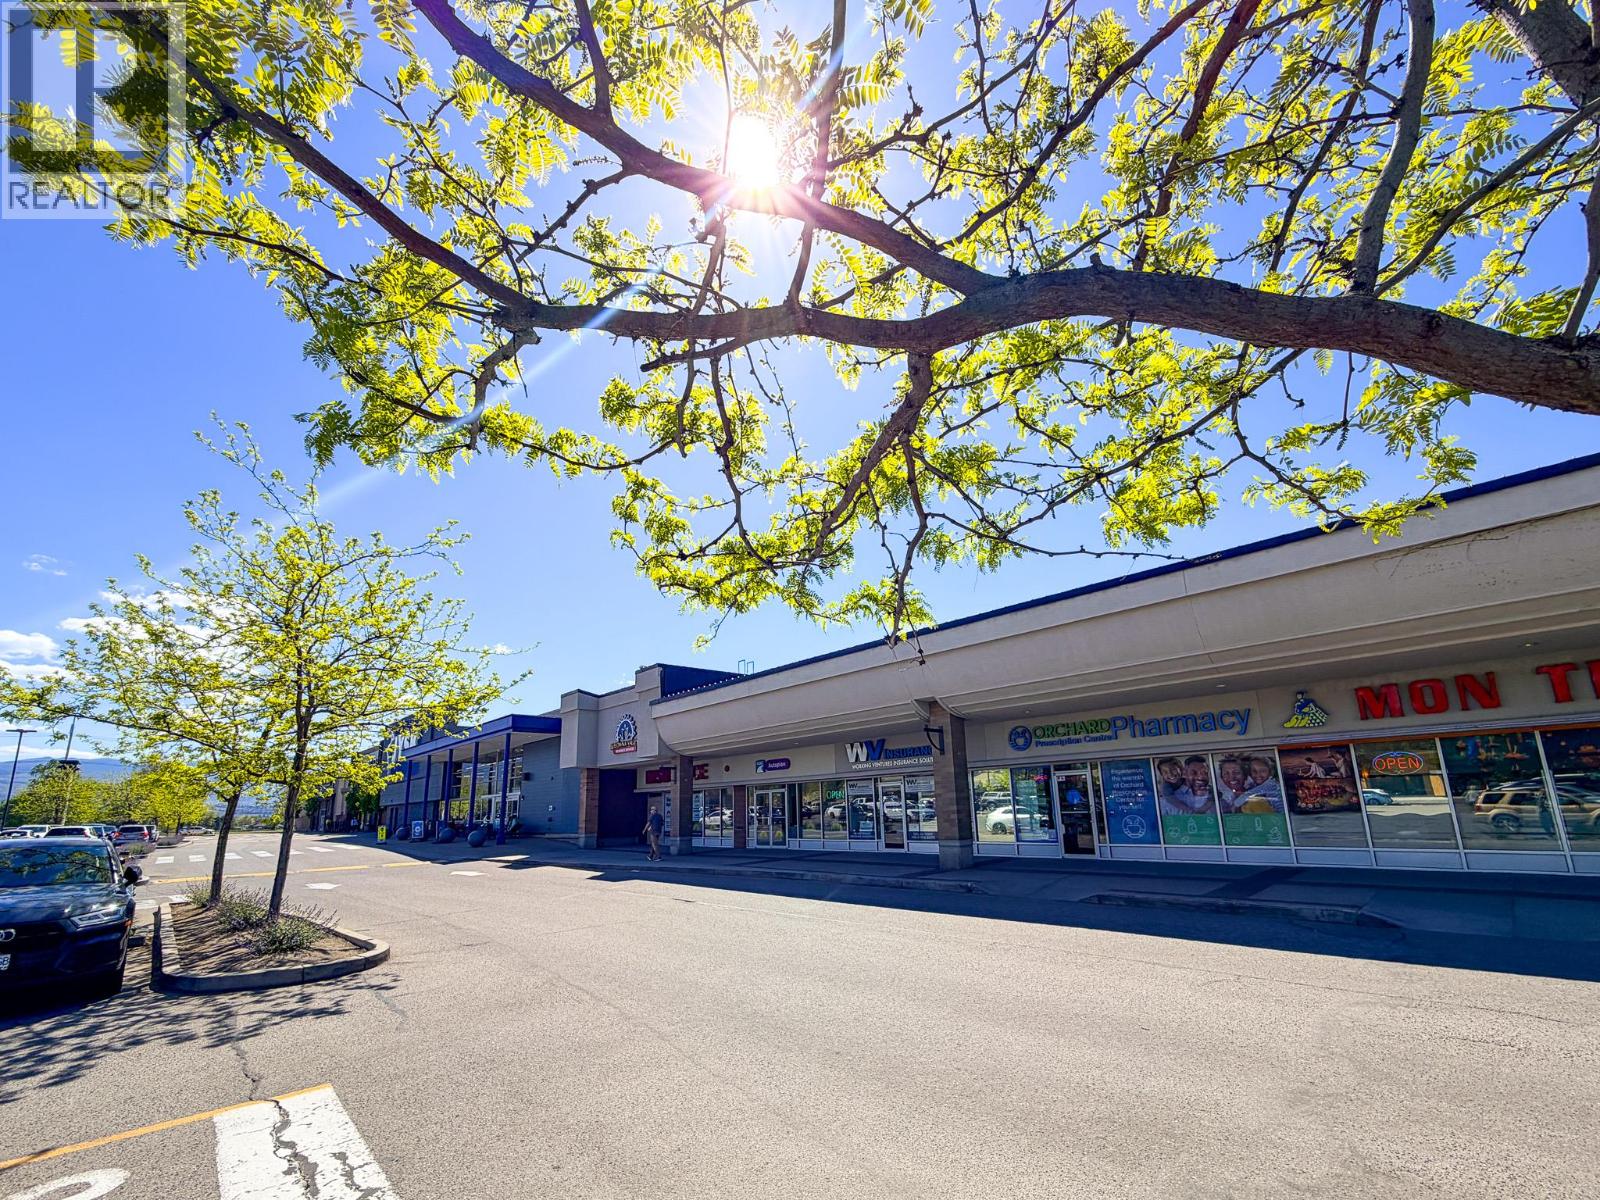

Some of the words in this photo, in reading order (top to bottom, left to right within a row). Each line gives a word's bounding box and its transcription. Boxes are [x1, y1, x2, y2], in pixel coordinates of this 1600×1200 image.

[1355, 671, 1502, 721] MON
[1032, 718, 1111, 740] ORCHARD
[1110, 708, 1251, 740] Pharmacy
[1035, 737, 1082, 748] Prescription
[845, 738, 886, 763] WV
[893, 758, 919, 766] INSURANCE
[1375, 757, 1420, 770] OPEN
[827, 790, 845, 800] OPEN
